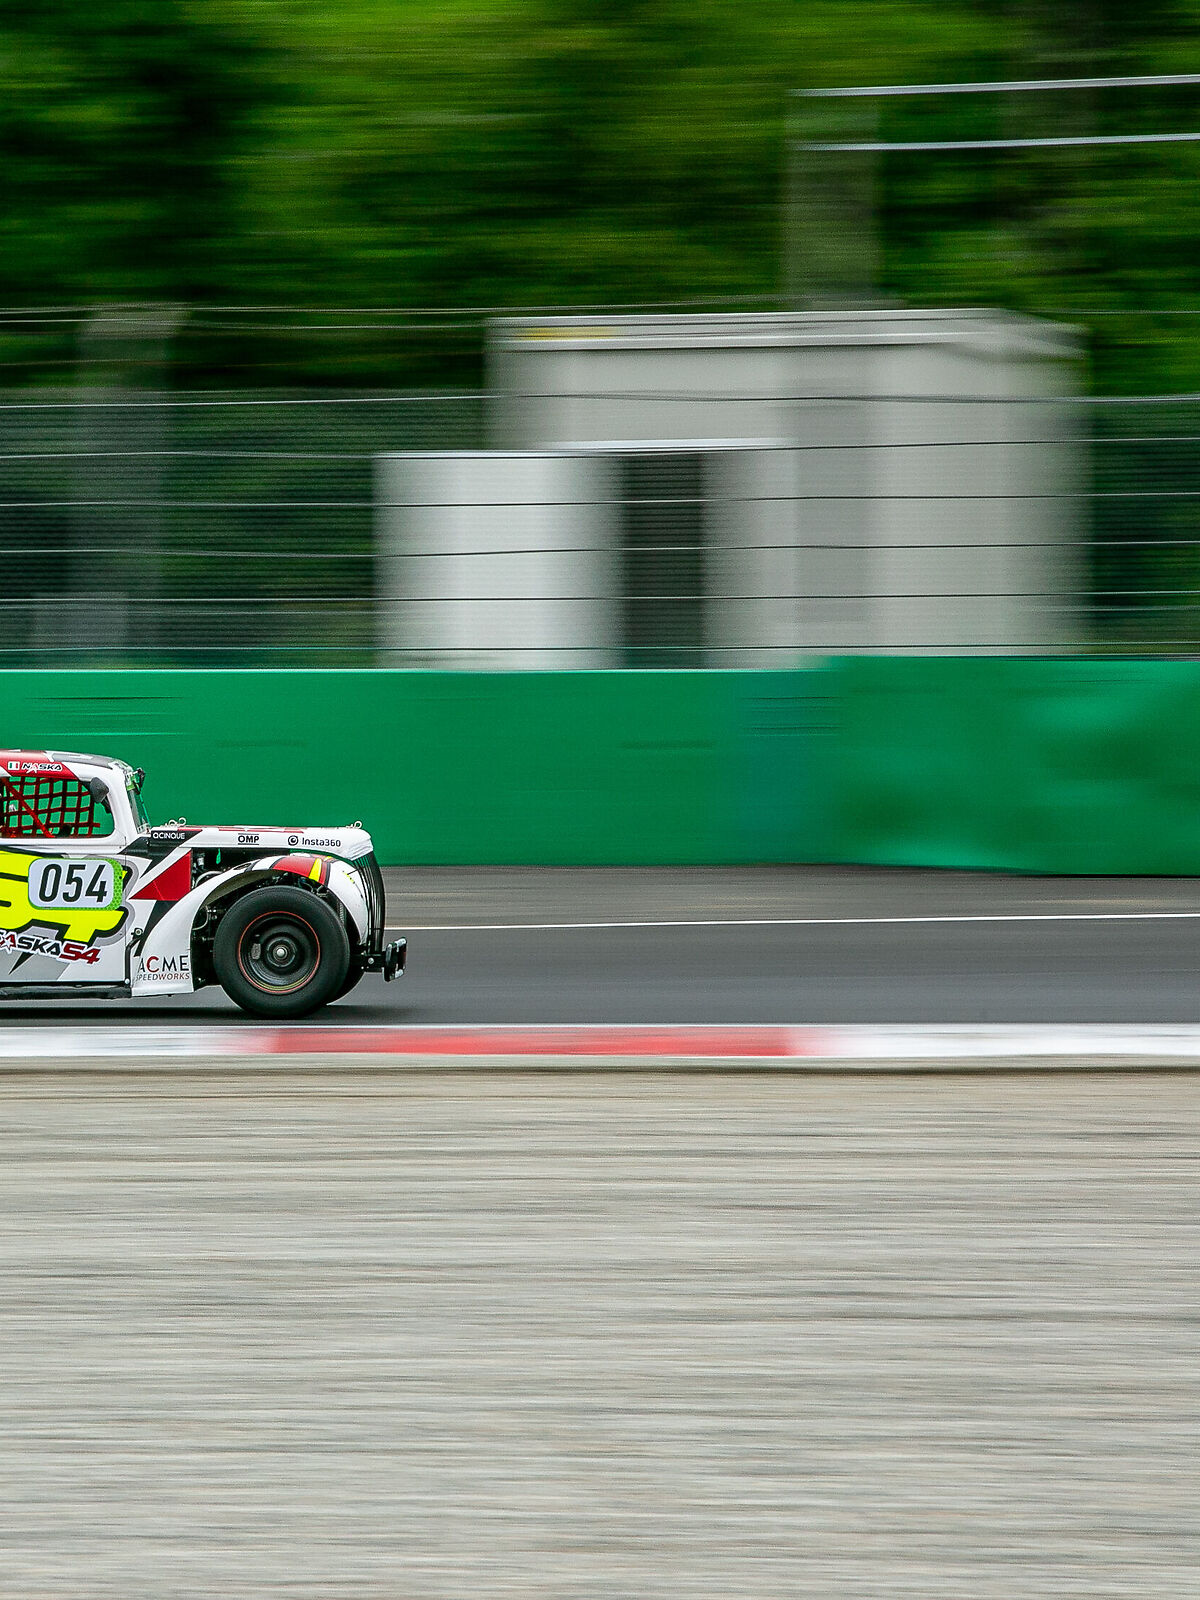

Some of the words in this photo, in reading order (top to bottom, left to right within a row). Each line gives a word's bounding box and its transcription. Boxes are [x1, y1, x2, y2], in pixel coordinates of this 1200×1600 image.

[23, 763, 62, 773] NASKA
[238, 835, 259, 844] OMP
[302, 838, 341, 847] Insta360
[38, 863, 107, 903] 054
[138, 955, 189, 973] ACME
[136, 973, 190, 981] SPEEDWORKS
